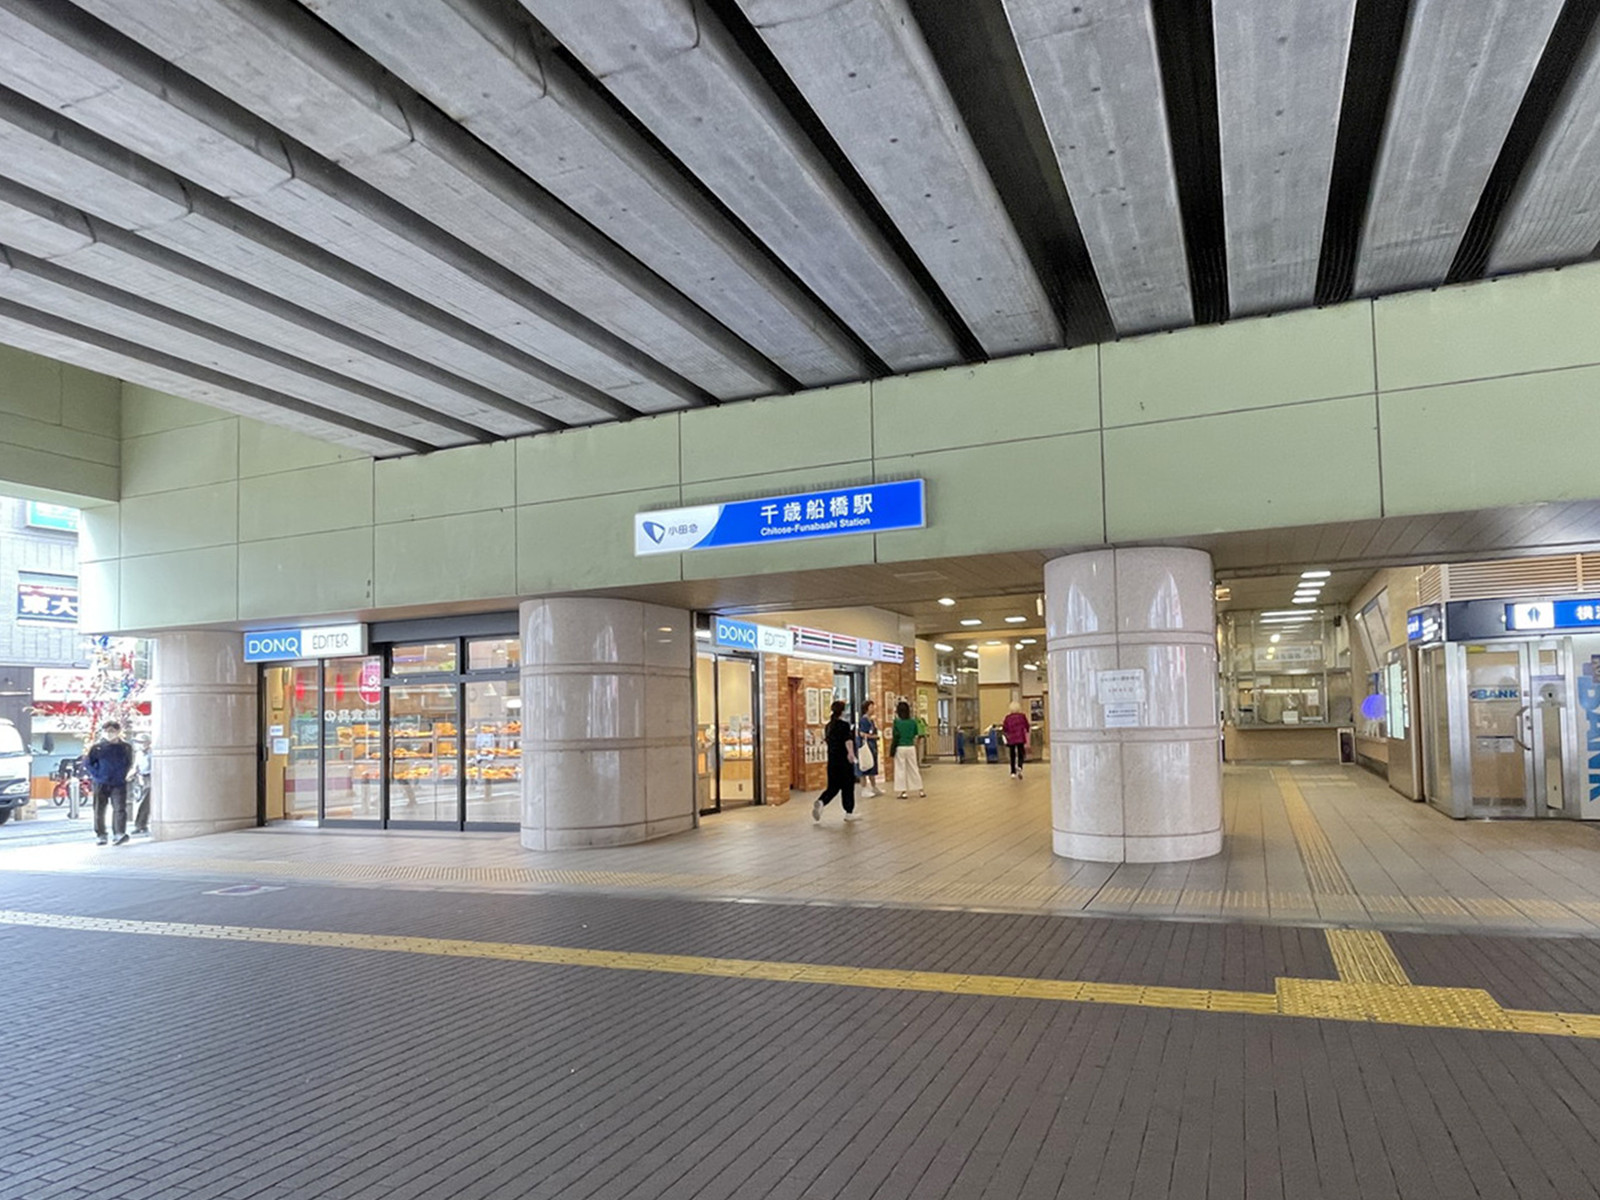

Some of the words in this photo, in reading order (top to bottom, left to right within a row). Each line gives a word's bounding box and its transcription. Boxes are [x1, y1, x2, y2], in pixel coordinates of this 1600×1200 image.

[761, 493, 873, 524] 千歳船橋駅
[668, 523, 698, 536] 小田急
[760, 521, 837, 536] Chitose-Funabashi
[840, 517, 871, 528] Station
[248, 636, 301, 657] DONQ
[312, 632, 349, 650] EDITER
[719, 624, 758, 650] DONQ
